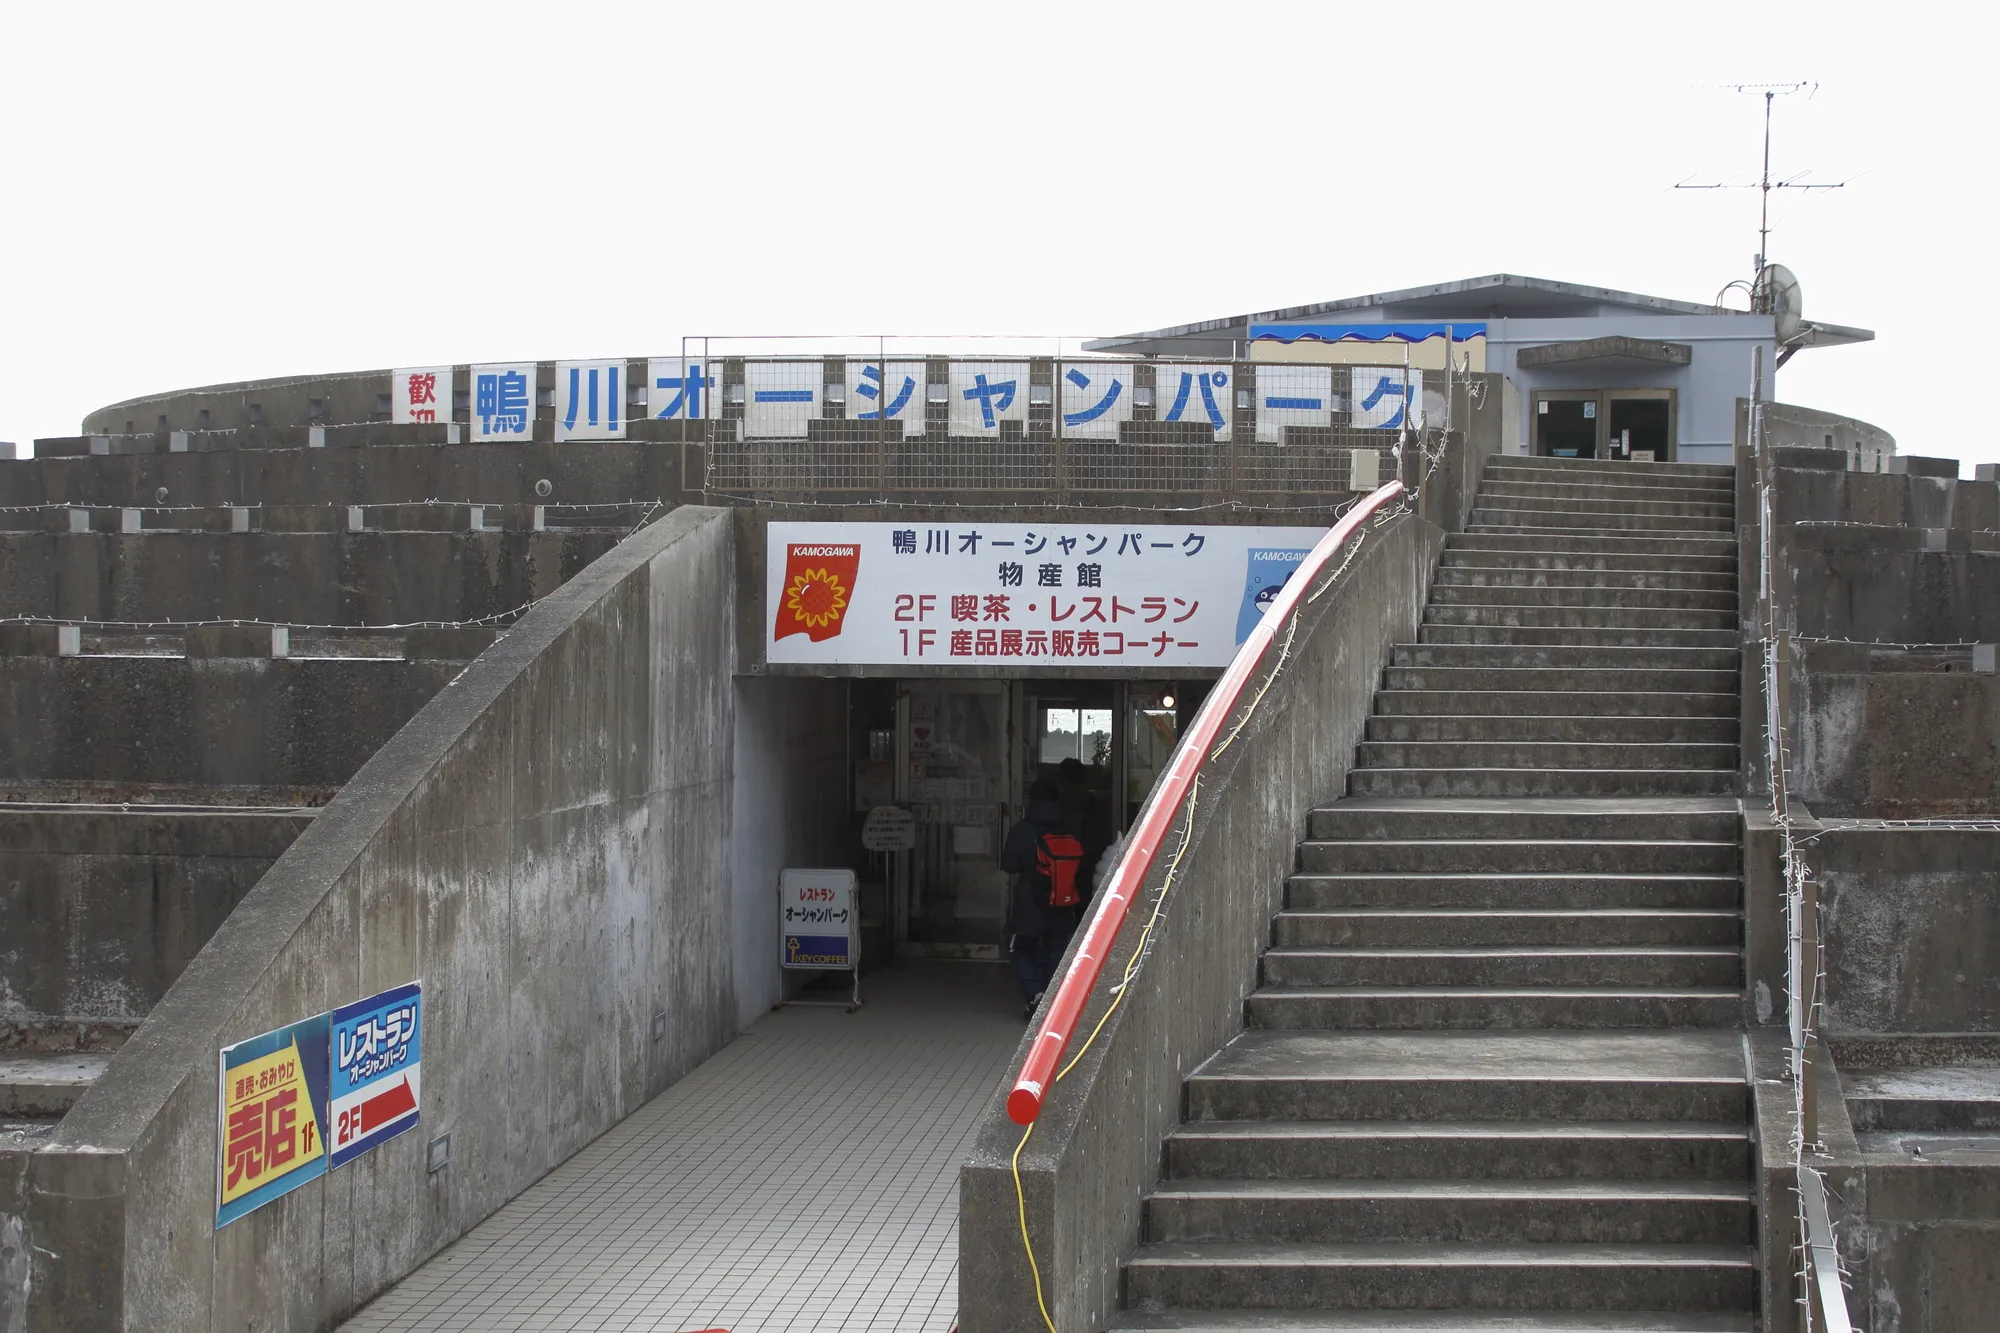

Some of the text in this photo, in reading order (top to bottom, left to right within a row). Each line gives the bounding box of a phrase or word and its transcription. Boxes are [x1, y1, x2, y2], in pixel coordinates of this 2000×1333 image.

[793, 546, 854, 557] KAMOGAWA
[892, 530, 1206, 557] 鴨川オーシャンパーク
[1253, 551, 1311, 562] KAMOGAW
[998, 562, 1103, 588] 物産館
[894, 594, 1200, 624] 2F 喫茶・レストラン
[898, 629, 1199, 658] 1F 産品展示販売コーナー
[799, 887, 836, 902] レストラン
[339, 1004, 418, 1069] レストラン
[337, 1103, 362, 1146] 2F
[227, 1088, 315, 1192] 売店 1F
